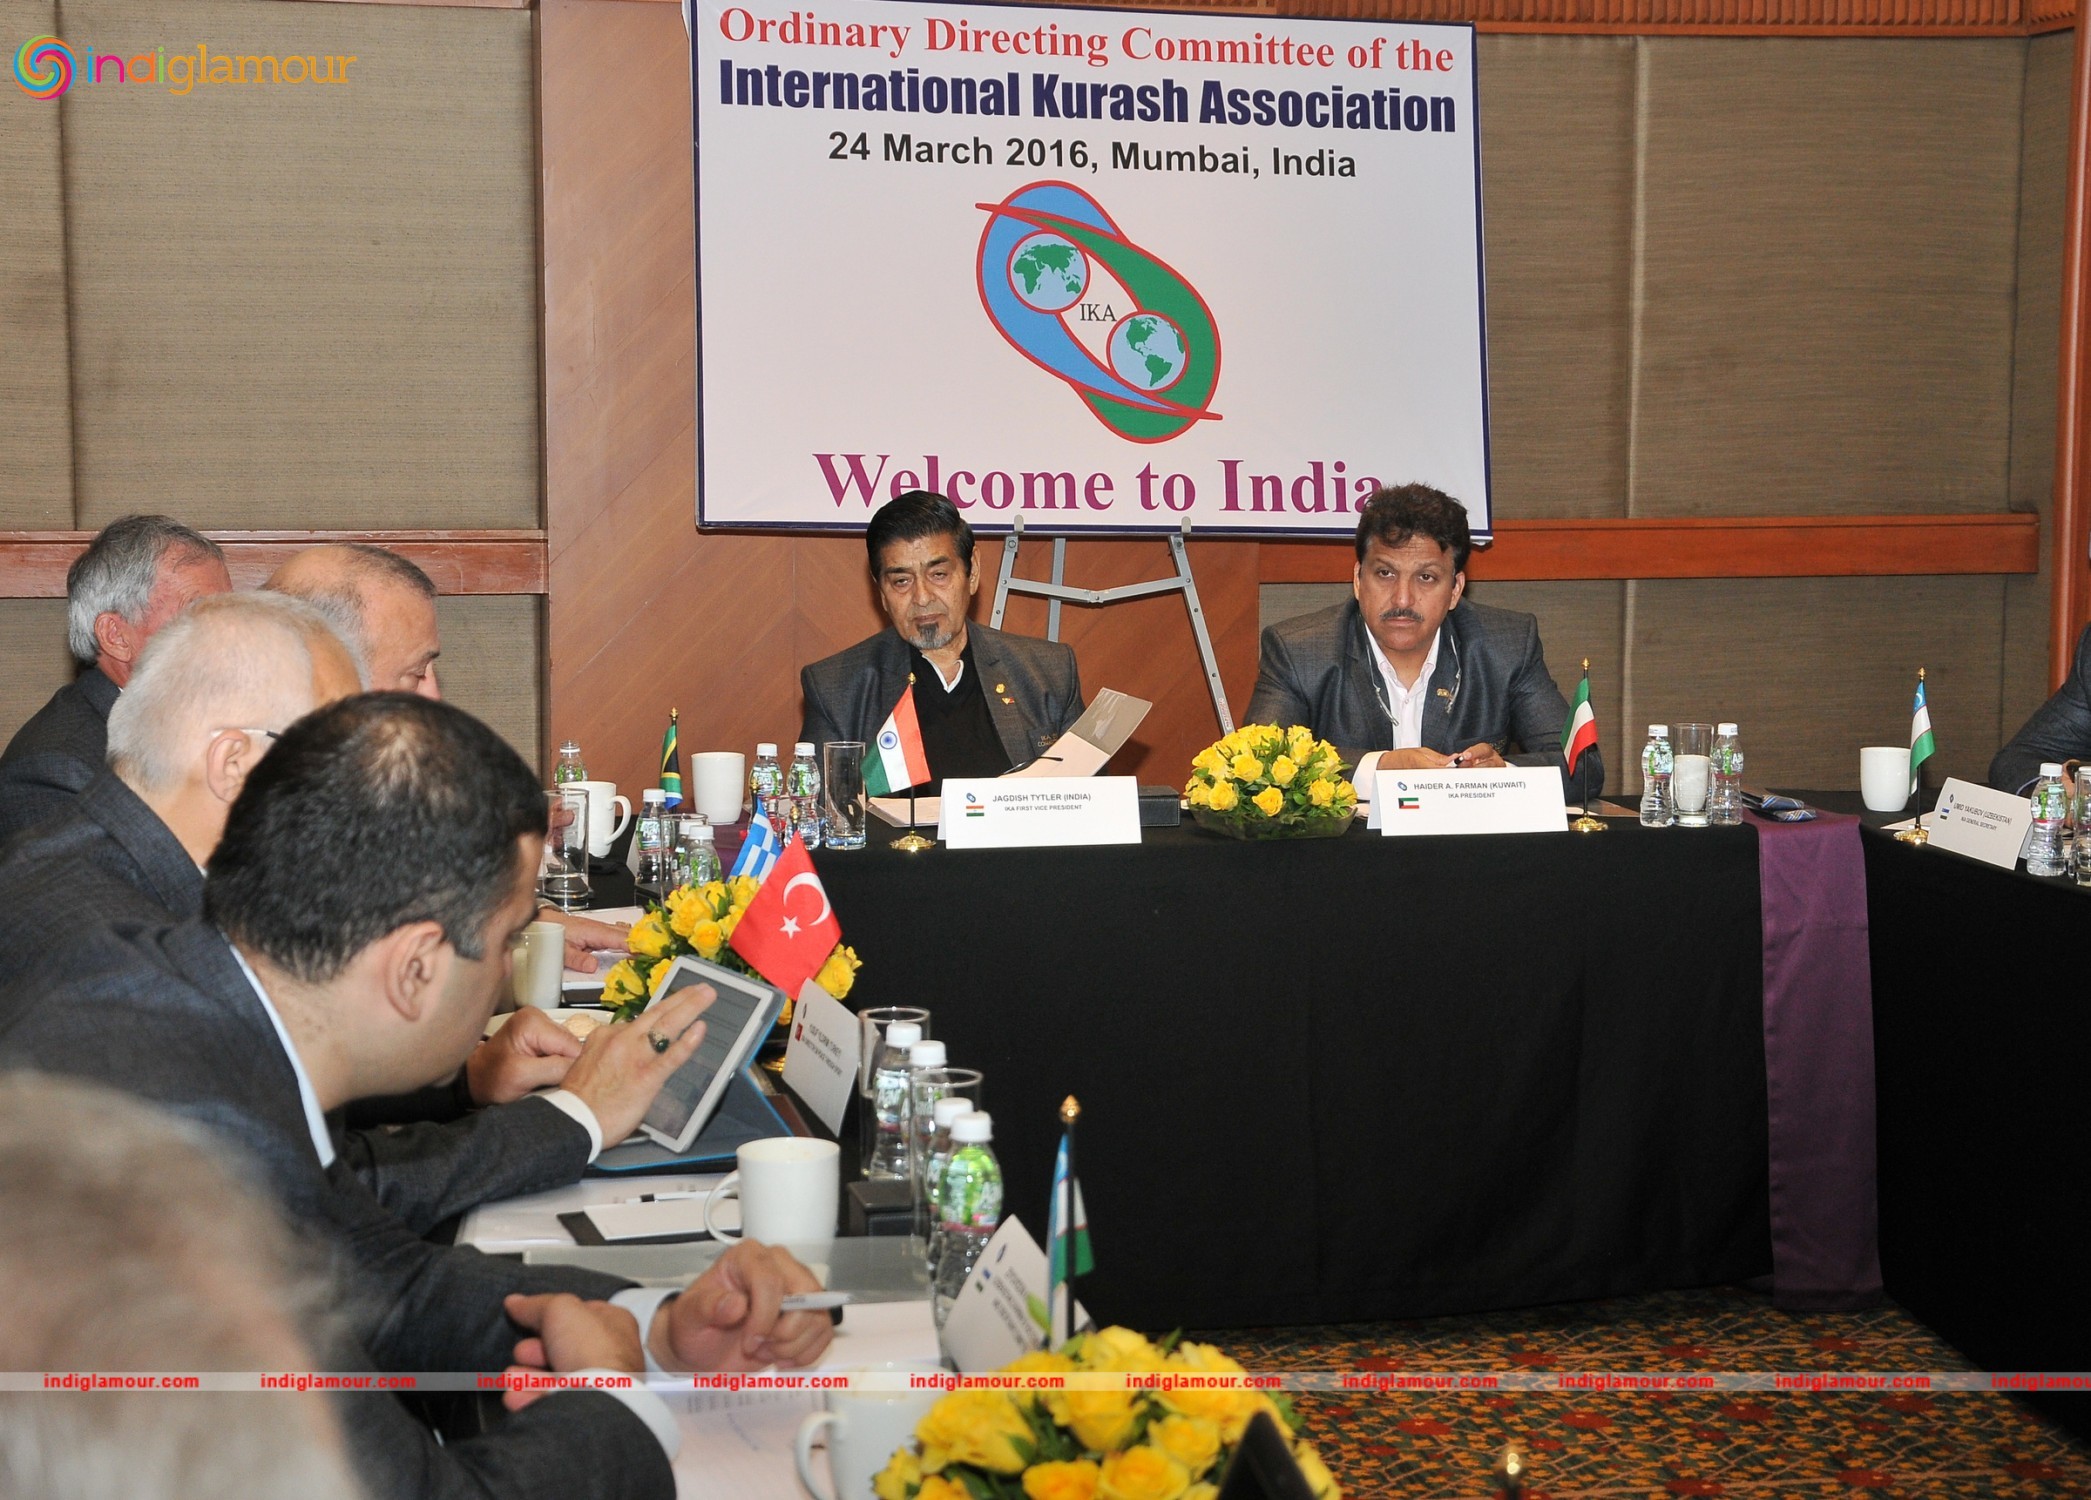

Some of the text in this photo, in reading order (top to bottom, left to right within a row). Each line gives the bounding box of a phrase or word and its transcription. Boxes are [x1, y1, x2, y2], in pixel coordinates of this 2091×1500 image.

[719, 8, 1454, 72] Ordinary Directing Committee of the
[719, 59, 1456, 133] International Kurash Association
[828, 131, 1356, 179] 24 March 2016, Mumbai, India
[1079, 303, 1117, 322] IKA
[812, 453, 1383, 514] Welcome to India
[992, 793, 1092, 803] JAGDISH TYTLER (INDIA)
[1413, 782, 1444, 790] HAIDER
[1489, 781, 1526, 790] (KUWAIT)
